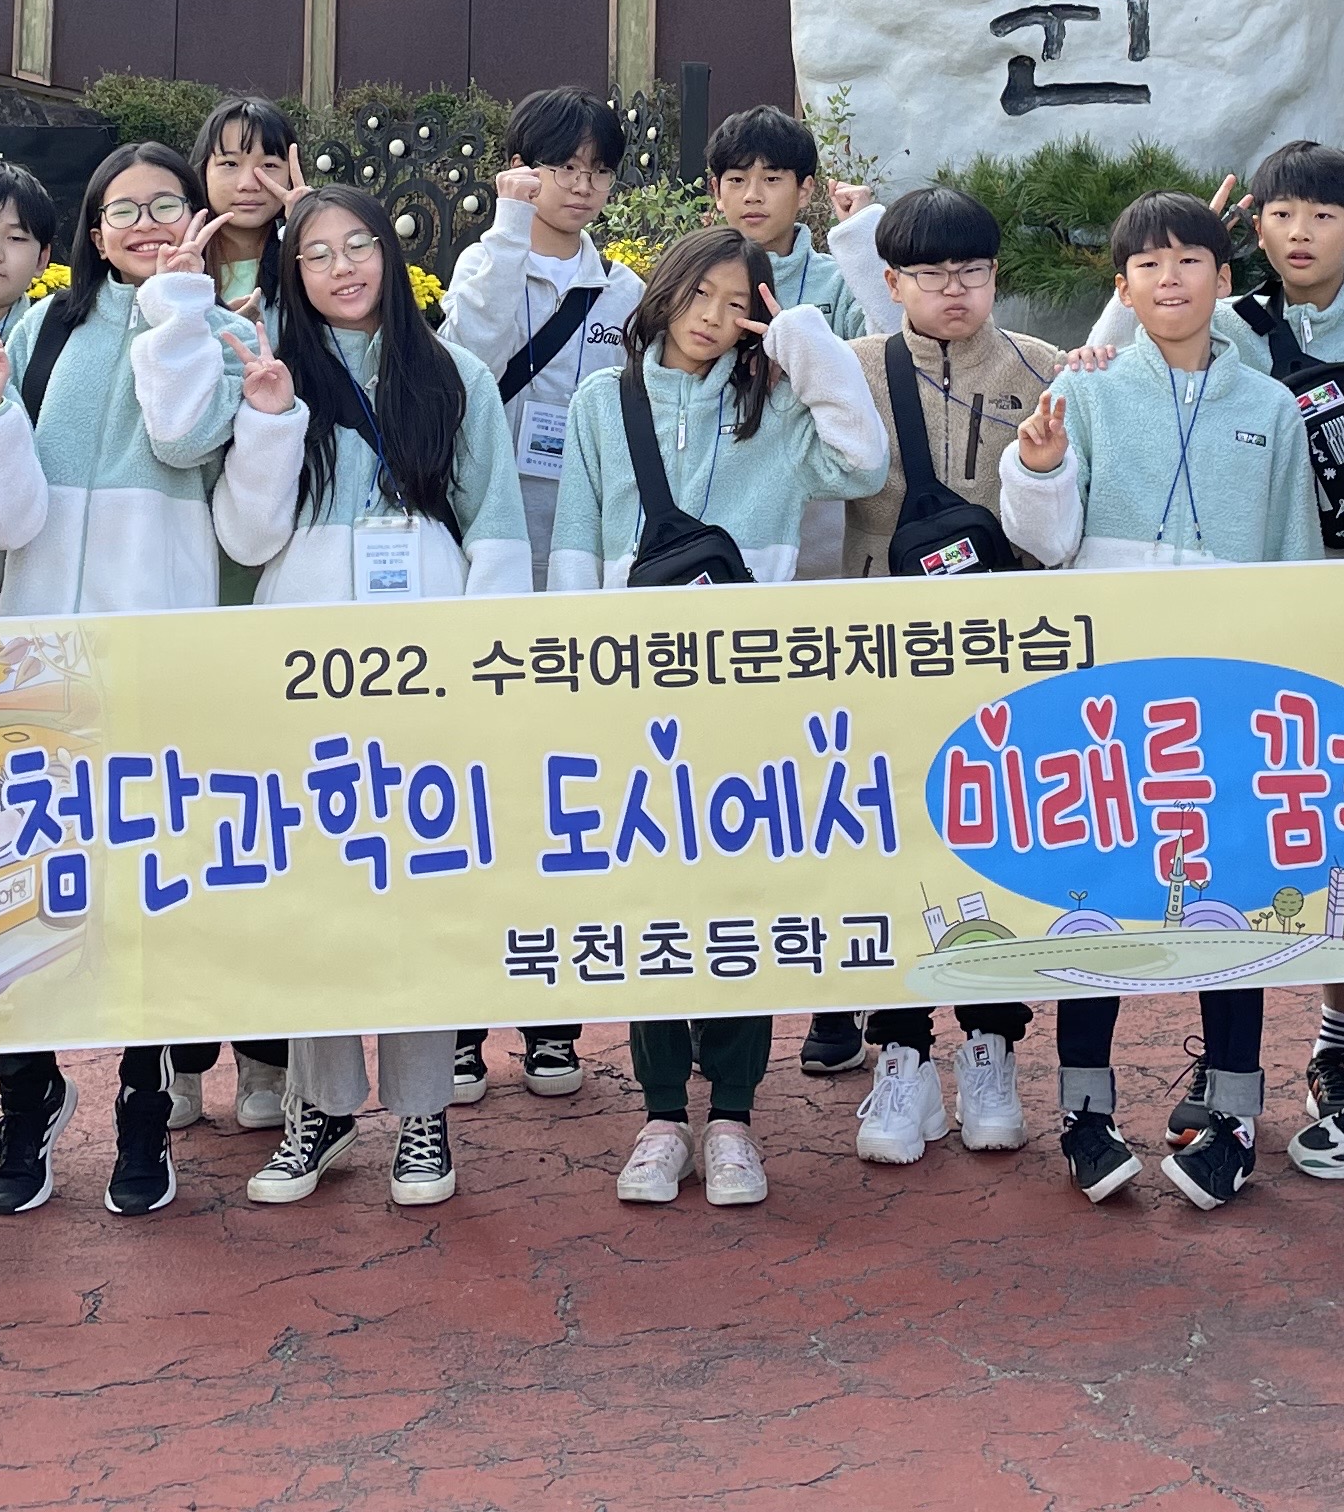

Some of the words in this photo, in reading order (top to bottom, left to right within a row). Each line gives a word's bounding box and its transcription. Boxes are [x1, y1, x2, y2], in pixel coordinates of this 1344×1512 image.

[587, 323, 625, 346] Daw
[284, 644, 446, 701] 2022.
[471, 613, 1096, 696] 수학여행[문화체험학습]
[5, 735, 494, 915] 첨단과학의
[541, 710, 899, 873] 도시에서
[946, 698, 1212, 884] 미래를
[504, 914, 896, 986] 북천초등학교
